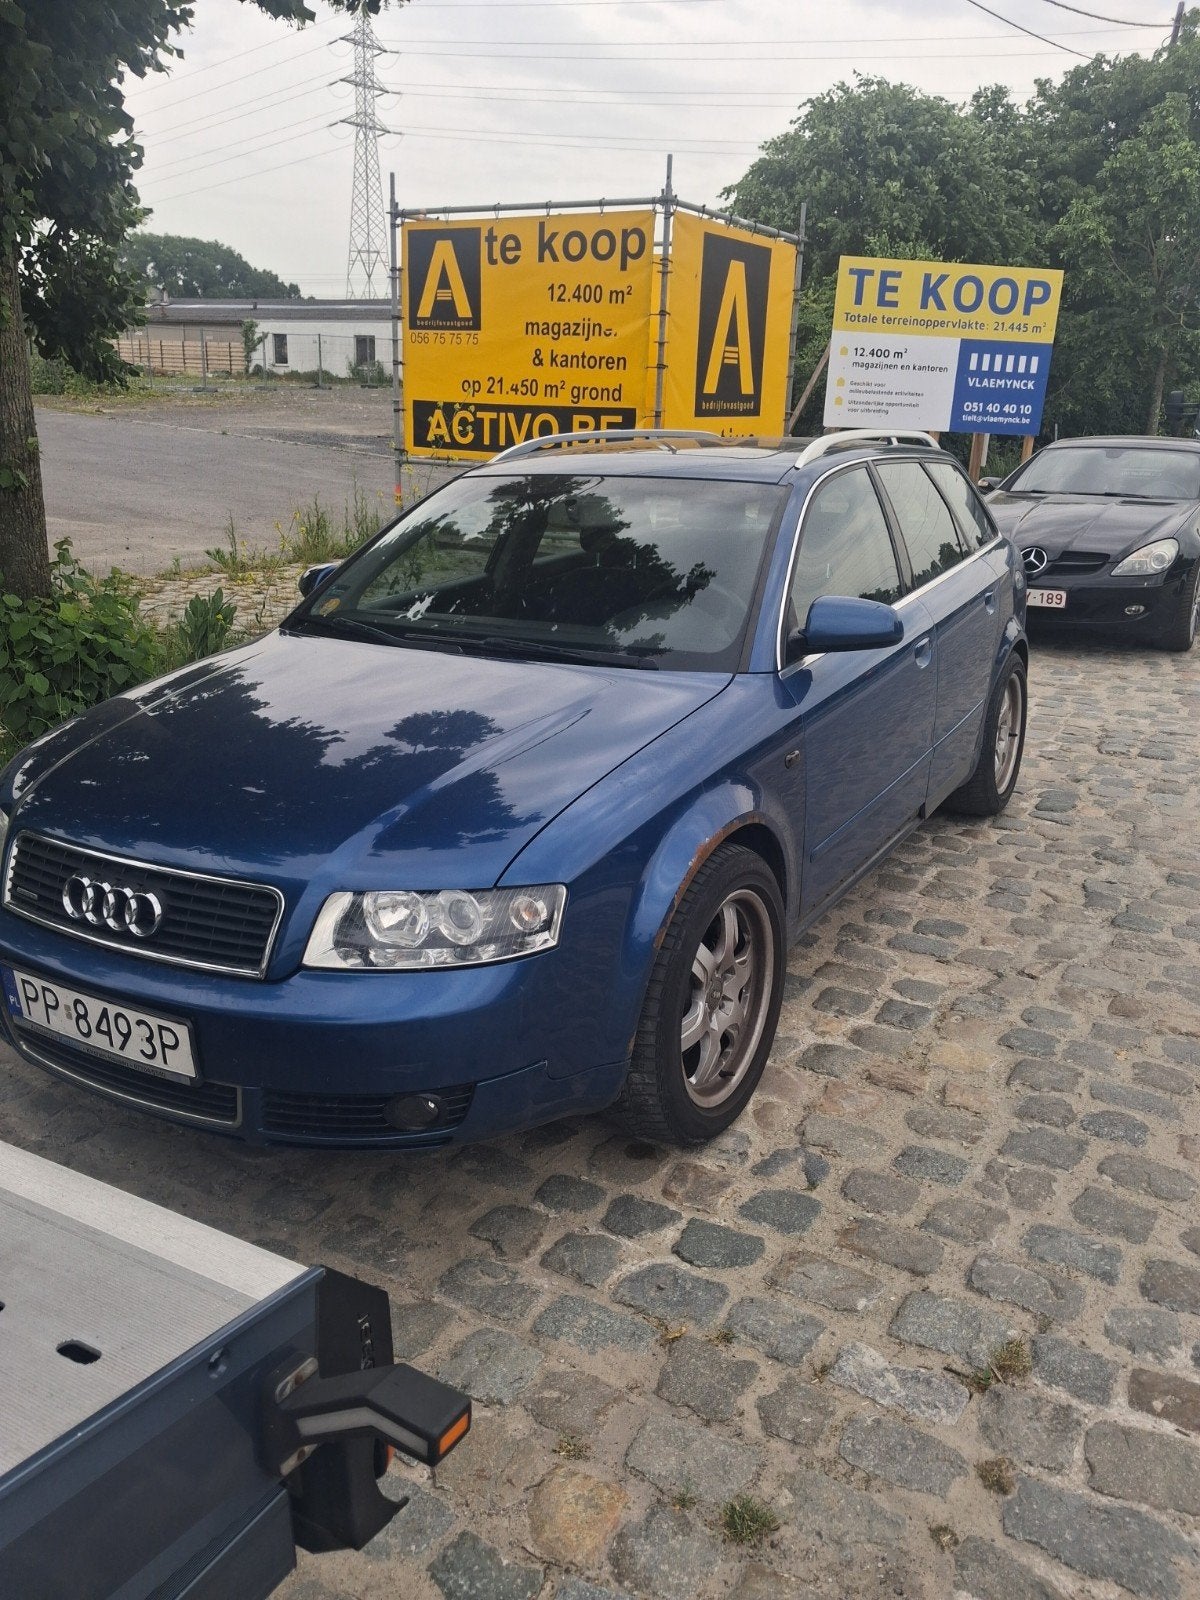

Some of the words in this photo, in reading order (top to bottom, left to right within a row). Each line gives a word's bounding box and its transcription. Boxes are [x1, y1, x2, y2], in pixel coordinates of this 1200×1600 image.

[484, 226, 521, 266] te
[538, 221, 646, 272] koop
[547, 283, 603, 304] 12.400
[608, 285, 633, 304] m²
[848, 267, 903, 308] TE
[920, 272, 1053, 317] KOOP
[525, 318, 618, 341] magazijne
[843, 312, 878, 325] Totale
[881, 312, 990, 333] terreinoppervlakte:
[993, 321, 1029, 333] 21.445
[410, 332, 430, 344] 056
[433, 332, 446, 345] 75
[449, 332, 462, 345] 75
[466, 333, 479, 346] 75
[532, 348, 544, 367] &
[550, 349, 627, 371] kantoren
[853, 347, 890, 359] 12.400
[852, 361, 898, 371] magazijnen
[912, 363, 949, 373] kantoren
[461, 379, 482, 398] op
[486, 376, 539, 397] 21.450
[544, 380, 566, 398] m²
[570, 383, 622, 404] grond
[968, 377, 1035, 390] VLAEMYNCK
[963, 401, 984, 412] 051
[986, 403, 1001, 413] 40
[1003, 403, 1018, 414] 40
[1020, 404, 1032, 415] 10
[962, 414, 1031, 424] tielt@vlaemynck.be
[20, 978, 60, 1024] PP
[72, 998, 180, 1066] 8493P
